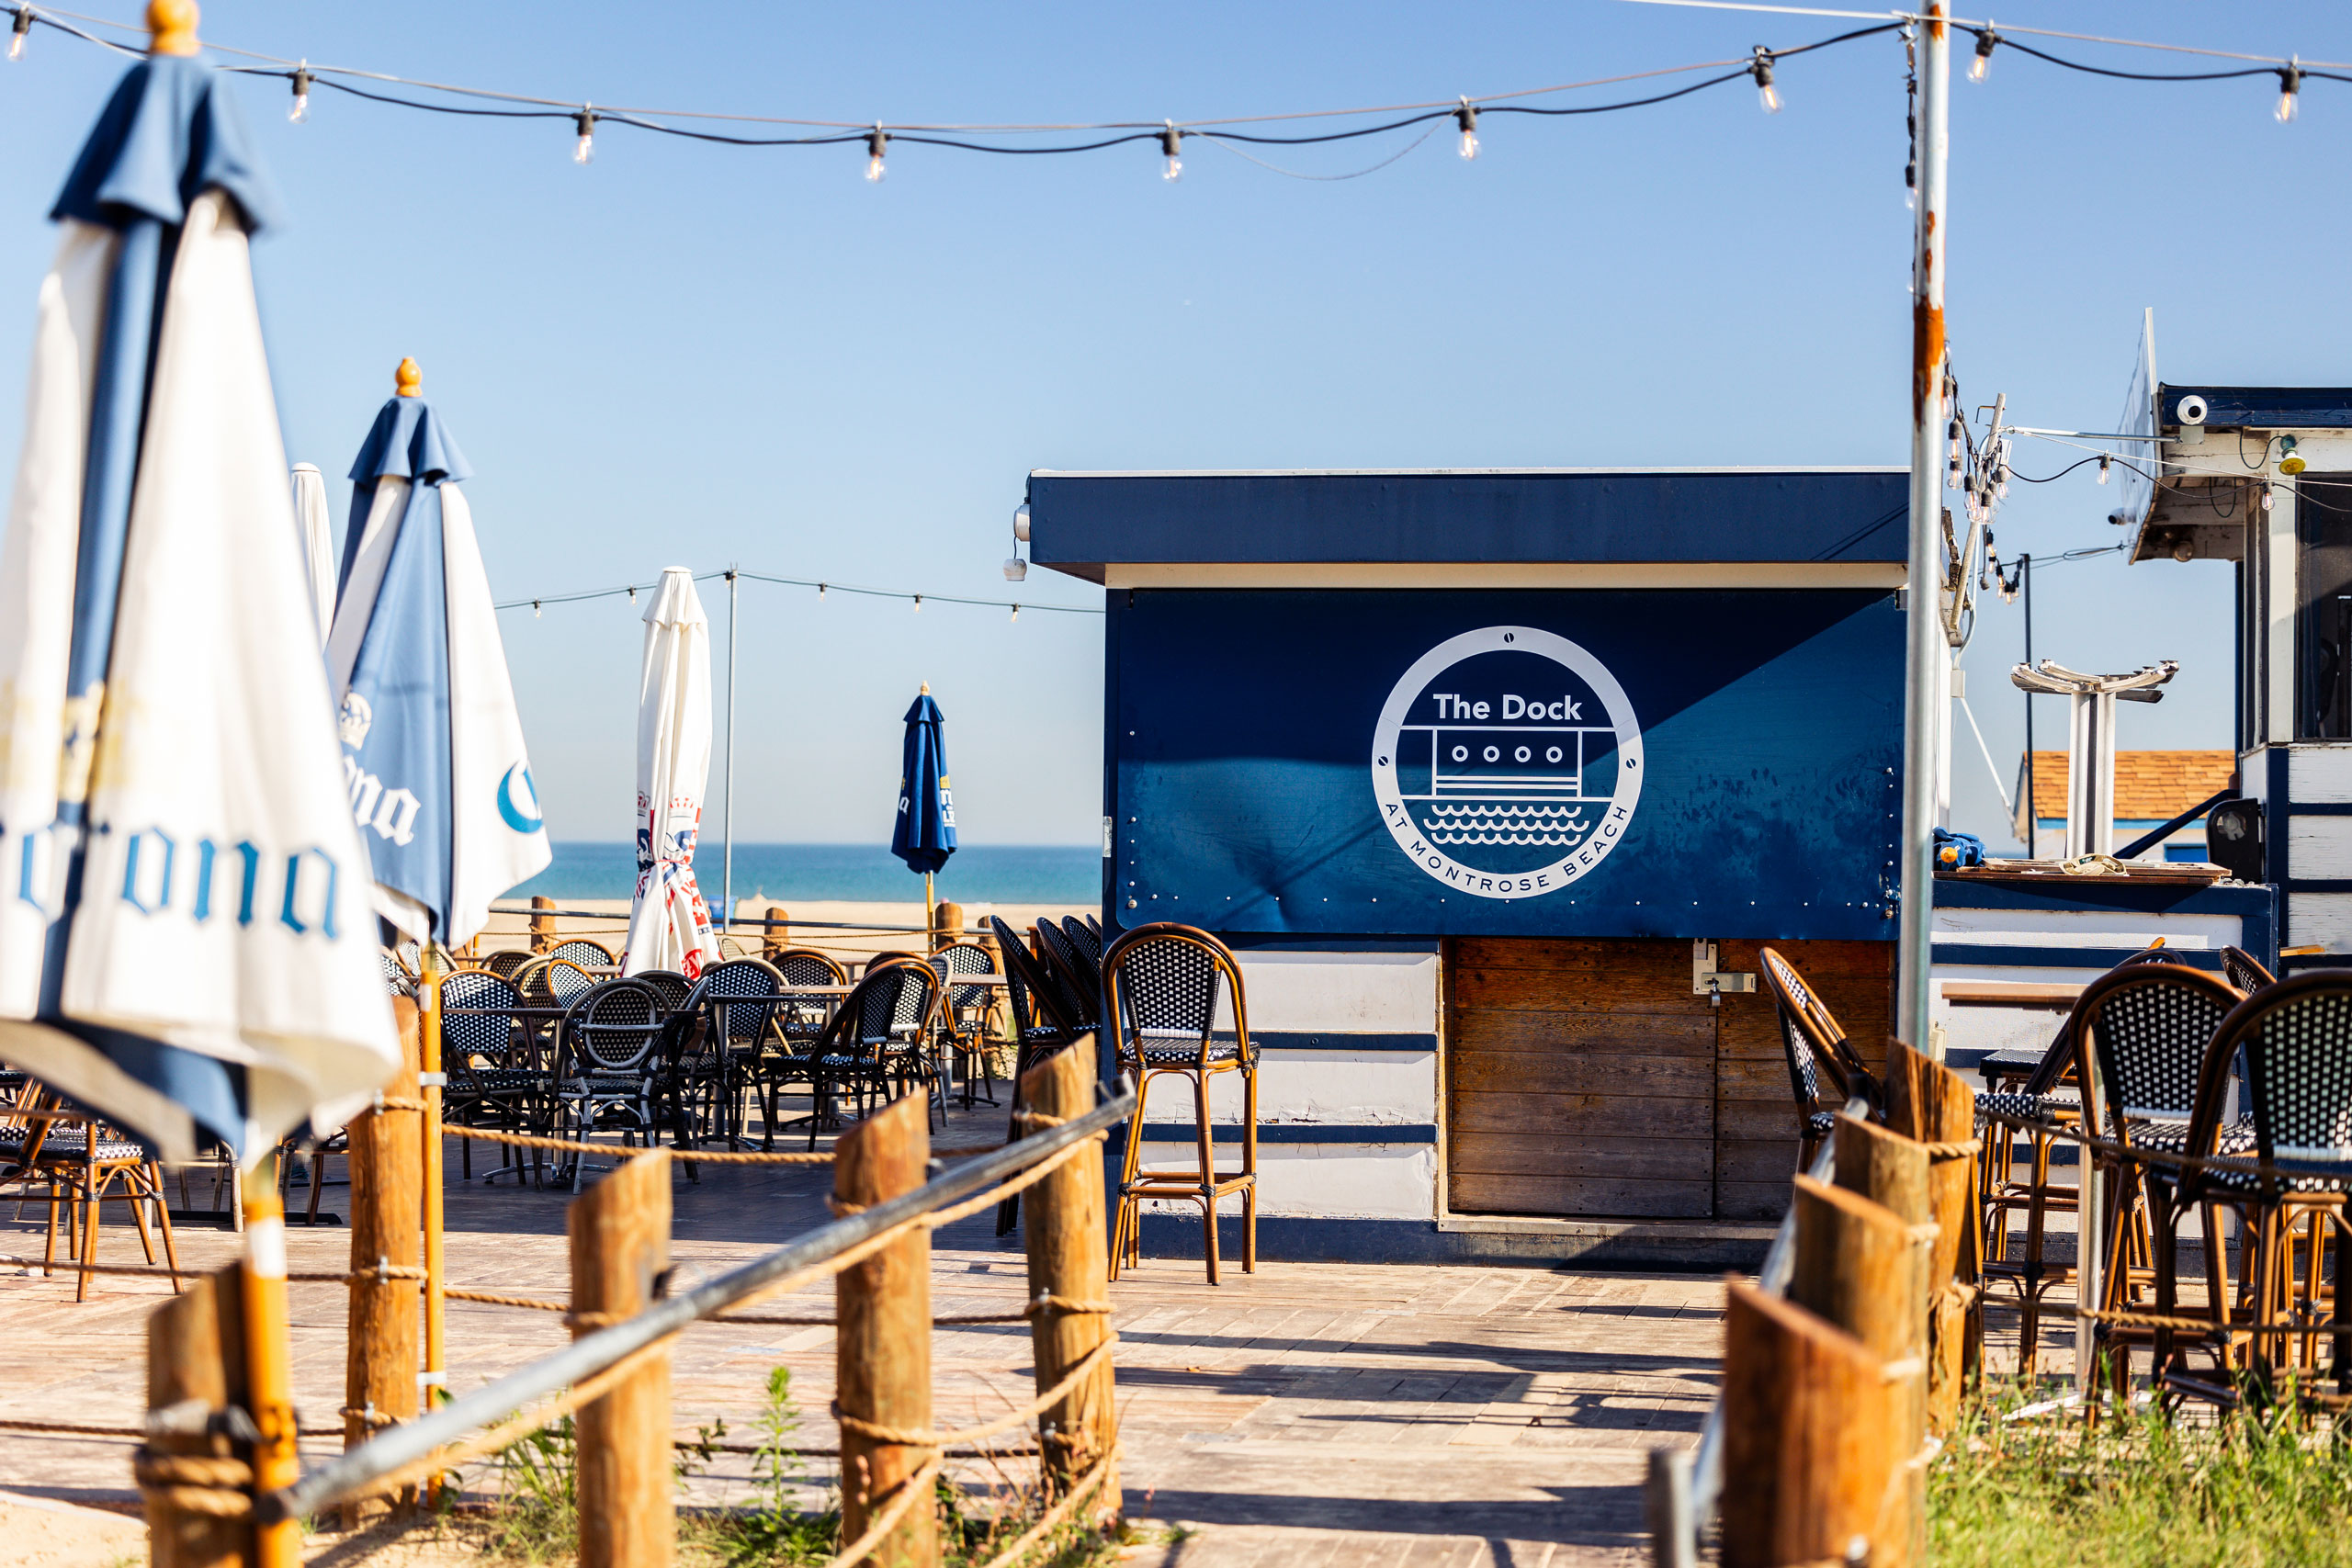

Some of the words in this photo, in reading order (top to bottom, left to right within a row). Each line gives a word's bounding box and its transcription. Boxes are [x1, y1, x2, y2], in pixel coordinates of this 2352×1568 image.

[1432, 694, 1490, 719] The
[1502, 694, 1583, 720] Dock
[1385, 803, 1408, 829] AT
[1411, 840, 1550, 893] MONTROSE
[1564, 807, 1627, 876] BEACH
